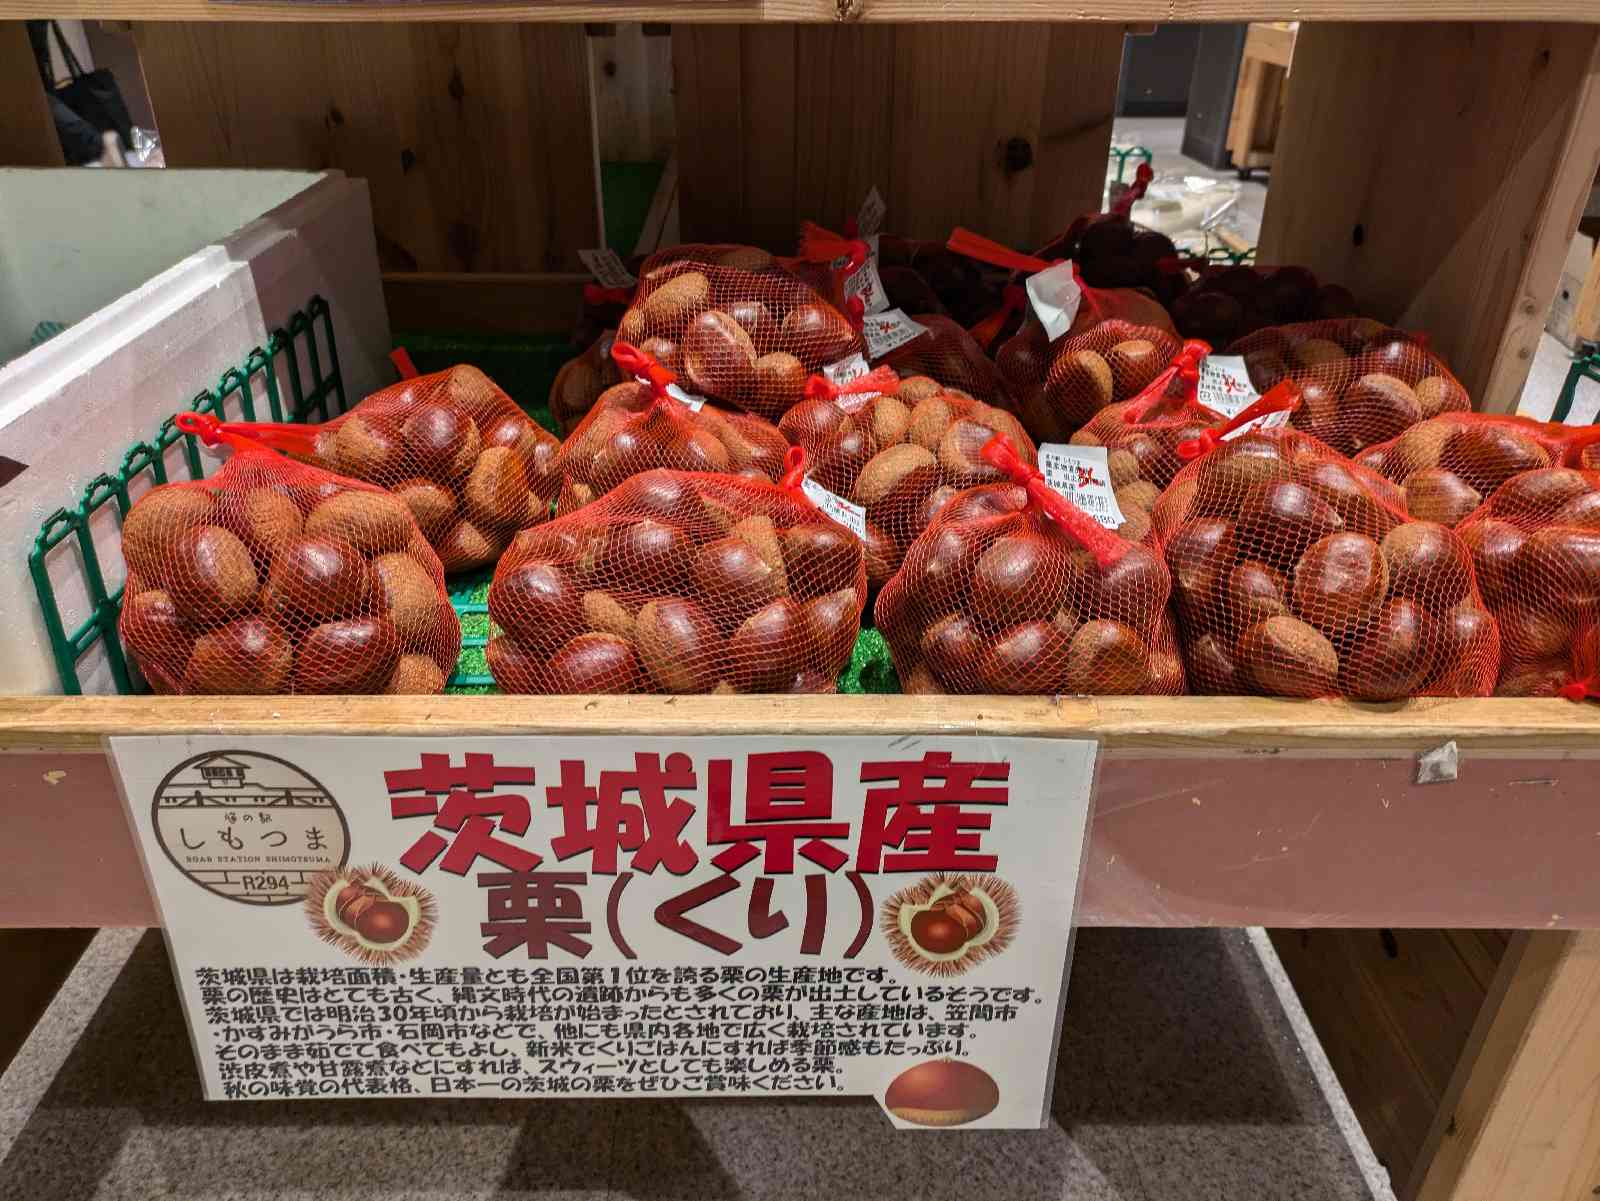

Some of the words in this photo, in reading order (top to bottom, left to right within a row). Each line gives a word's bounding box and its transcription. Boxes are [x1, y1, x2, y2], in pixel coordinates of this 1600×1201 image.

[384, 751, 1010, 875] 茨城県産
[179, 826, 328, 850] しもつま
[217, 855, 261, 863] STATION
[265, 855, 331, 864] SHIMOTSUMA
[242, 875, 290, 891] R294
[477, 870, 875, 960] 栗(くり)
